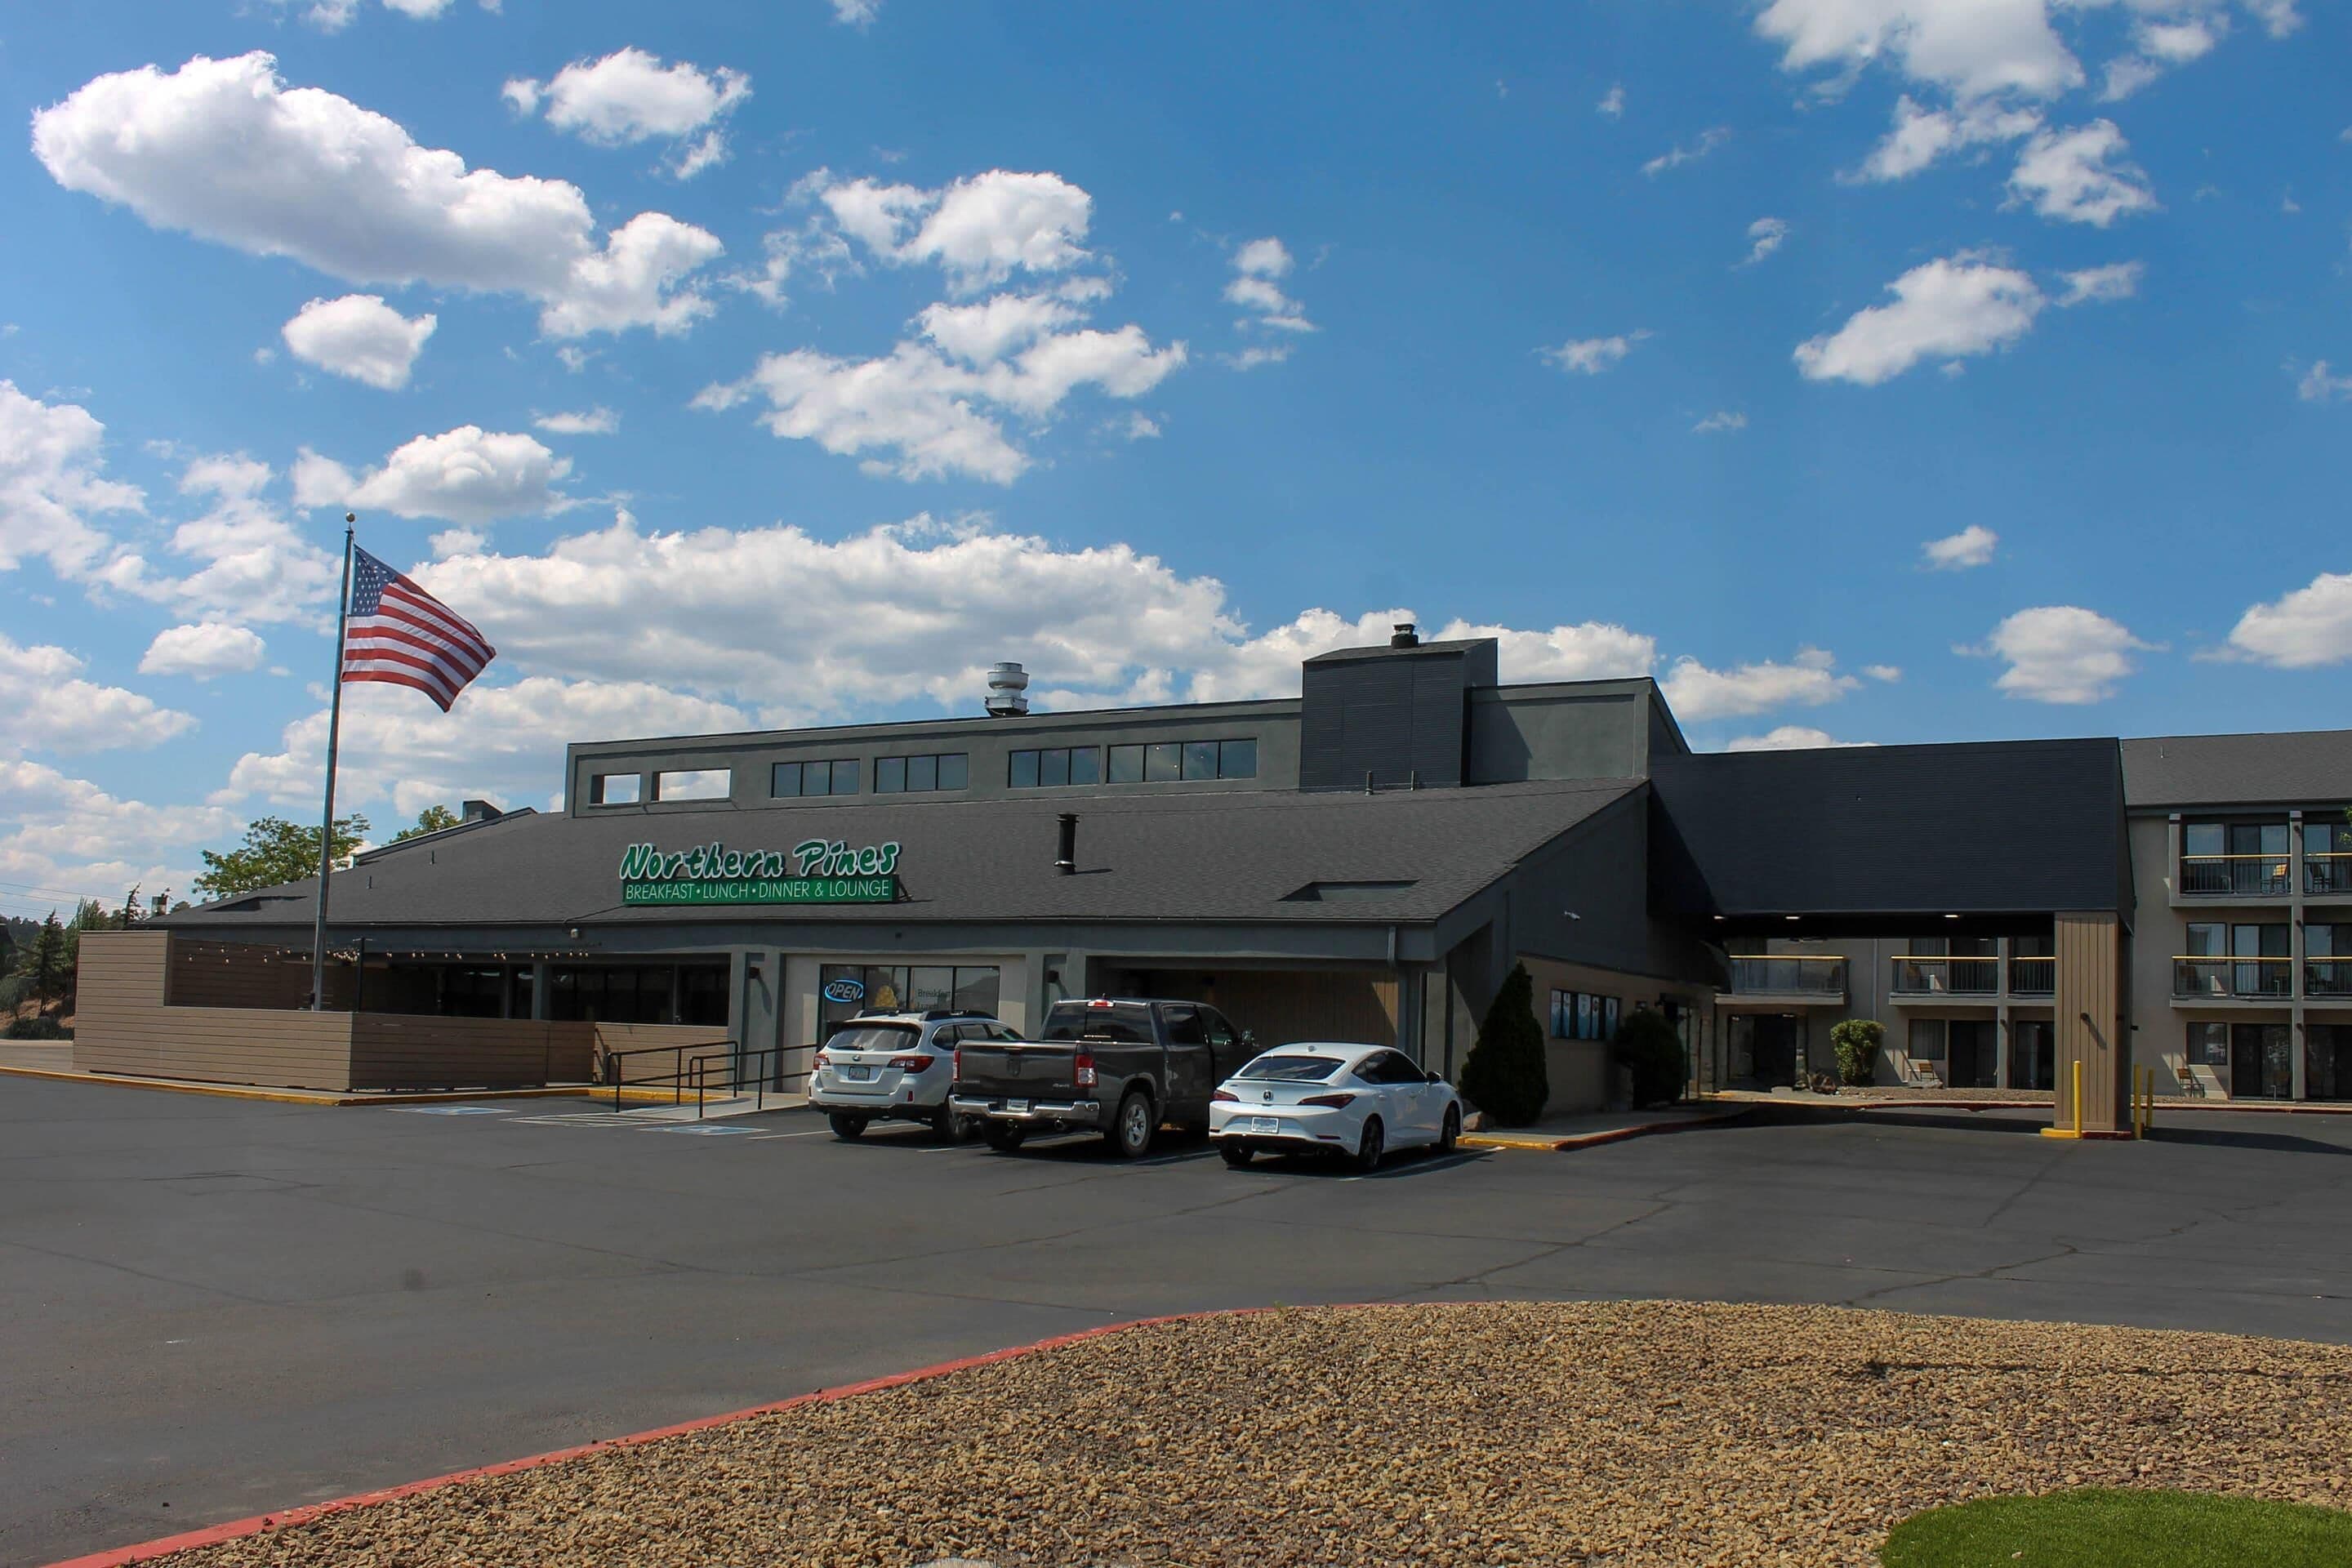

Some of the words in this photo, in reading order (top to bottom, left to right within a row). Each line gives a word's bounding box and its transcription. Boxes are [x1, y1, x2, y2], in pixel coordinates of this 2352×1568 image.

[620, 841, 784, 880] Northern
[792, 838, 901, 877] Pines
[626, 883, 694, 900] BREAKFAST
[702, 882, 748, 899] LUNCH
[759, 880, 810, 898] DINNER
[814, 882, 824, 898] &
[829, 879, 890, 898] LOUNGE
[828, 982, 861, 1000] OPEN
